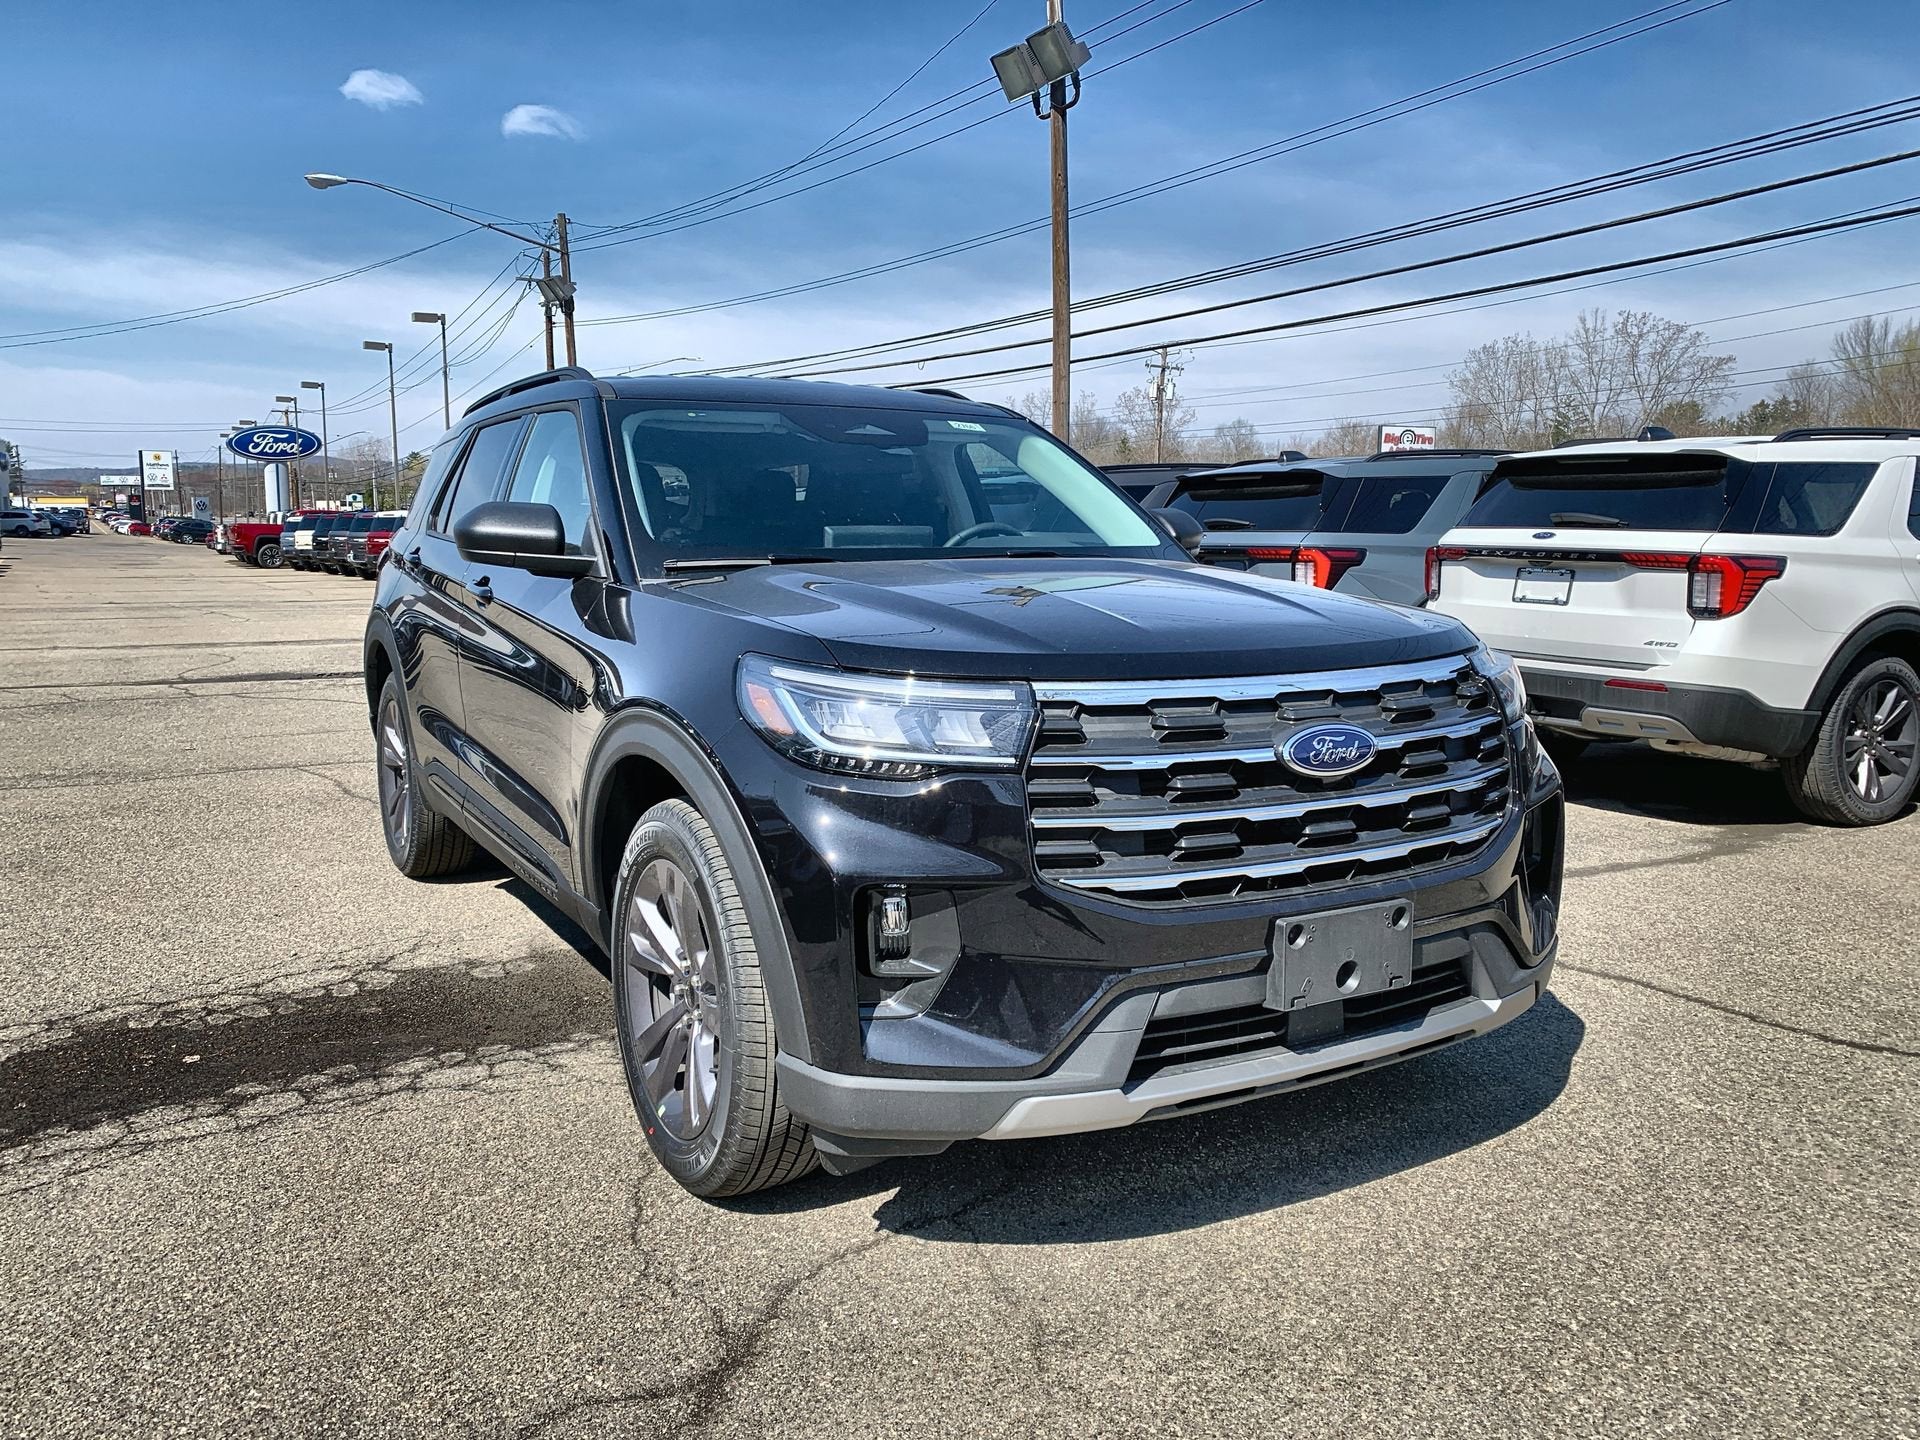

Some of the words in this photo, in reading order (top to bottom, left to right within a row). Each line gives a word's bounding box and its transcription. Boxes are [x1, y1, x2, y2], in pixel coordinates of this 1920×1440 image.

[248, 432, 304, 454] Ford
[1384, 433, 1400, 446] Big
[1416, 434, 1433, 445] Tire
[1481, 550, 1600, 559] EXPLORER
[1643, 640, 1679, 648] 4WD
[1309, 735, 1360, 765] Ford
